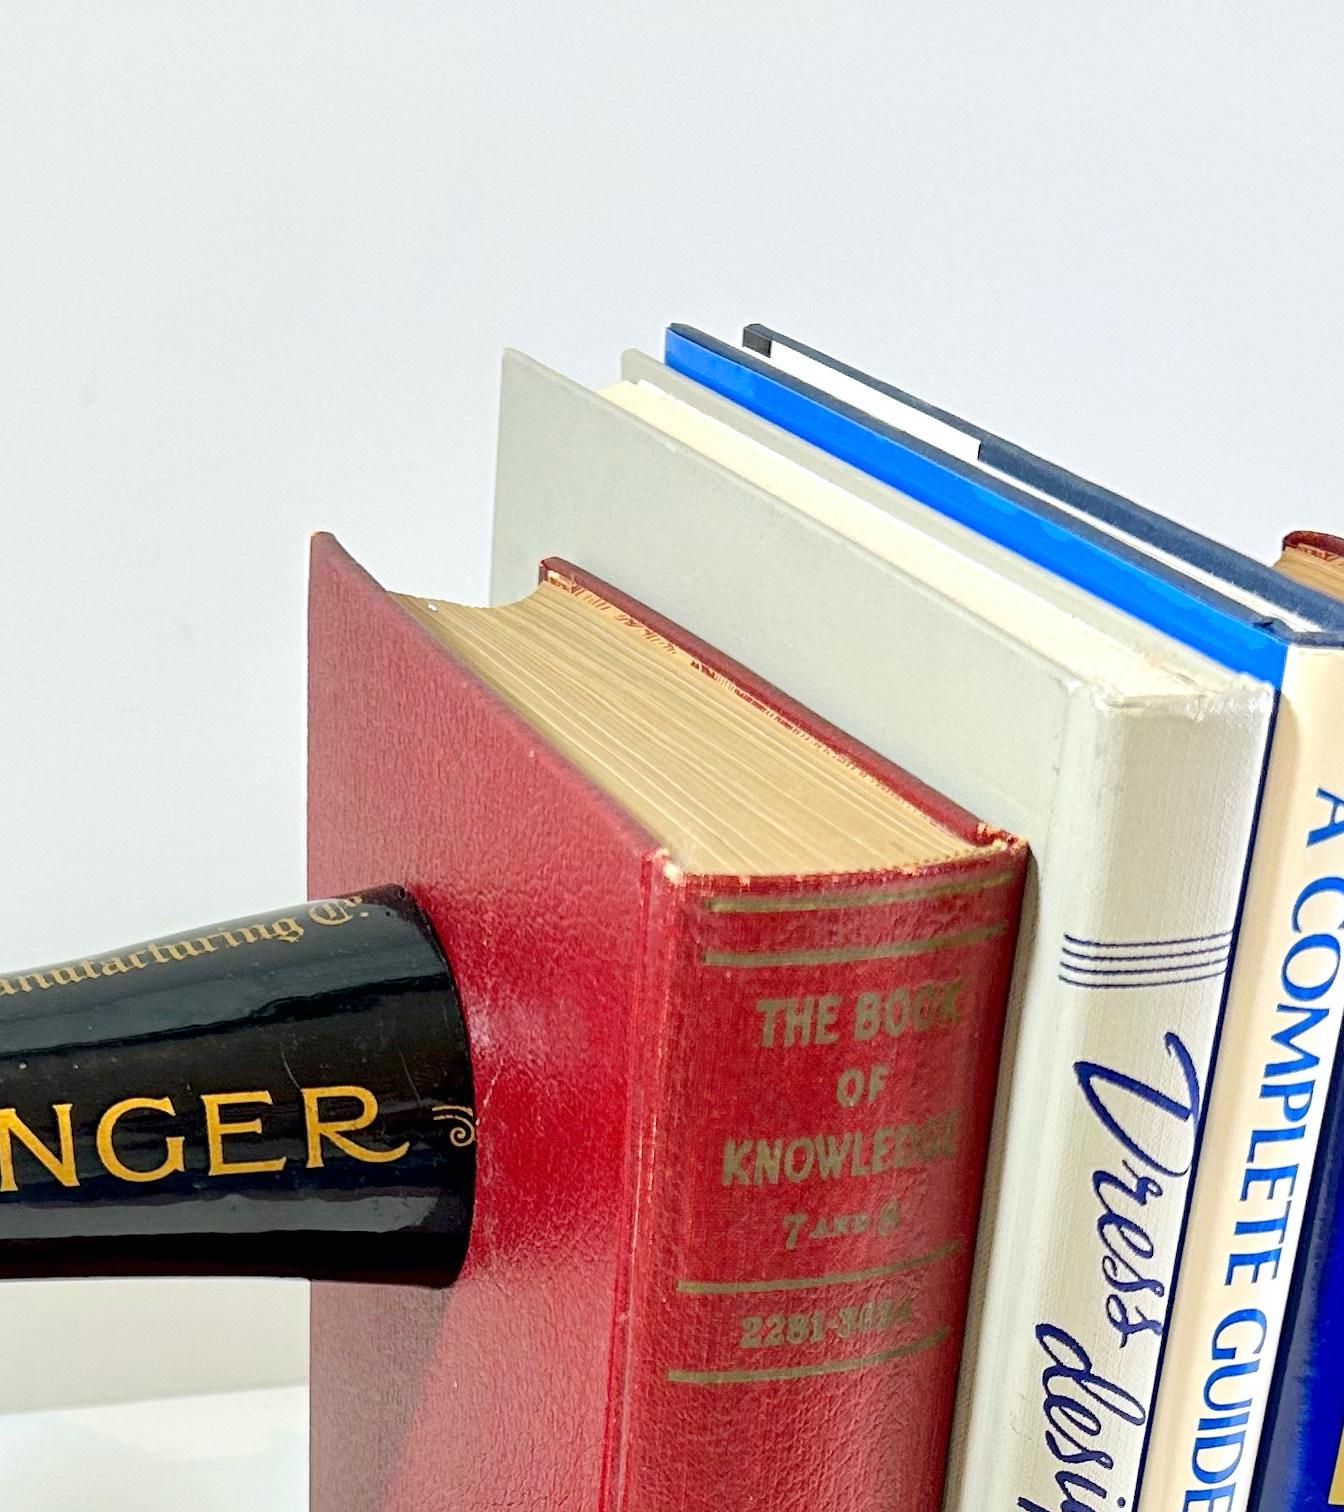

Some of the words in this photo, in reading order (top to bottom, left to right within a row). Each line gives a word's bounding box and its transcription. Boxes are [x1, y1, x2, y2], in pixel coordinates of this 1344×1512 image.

[756, 992, 842, 1049] THE
[854, 978, 965, 1040] BOOK
[836, 1065, 892, 1108] OF
[1073, 1031, 1202, 1350] Dress
[783, 1213, 807, 1250] 7
[809, 1213, 870, 1239] AND
